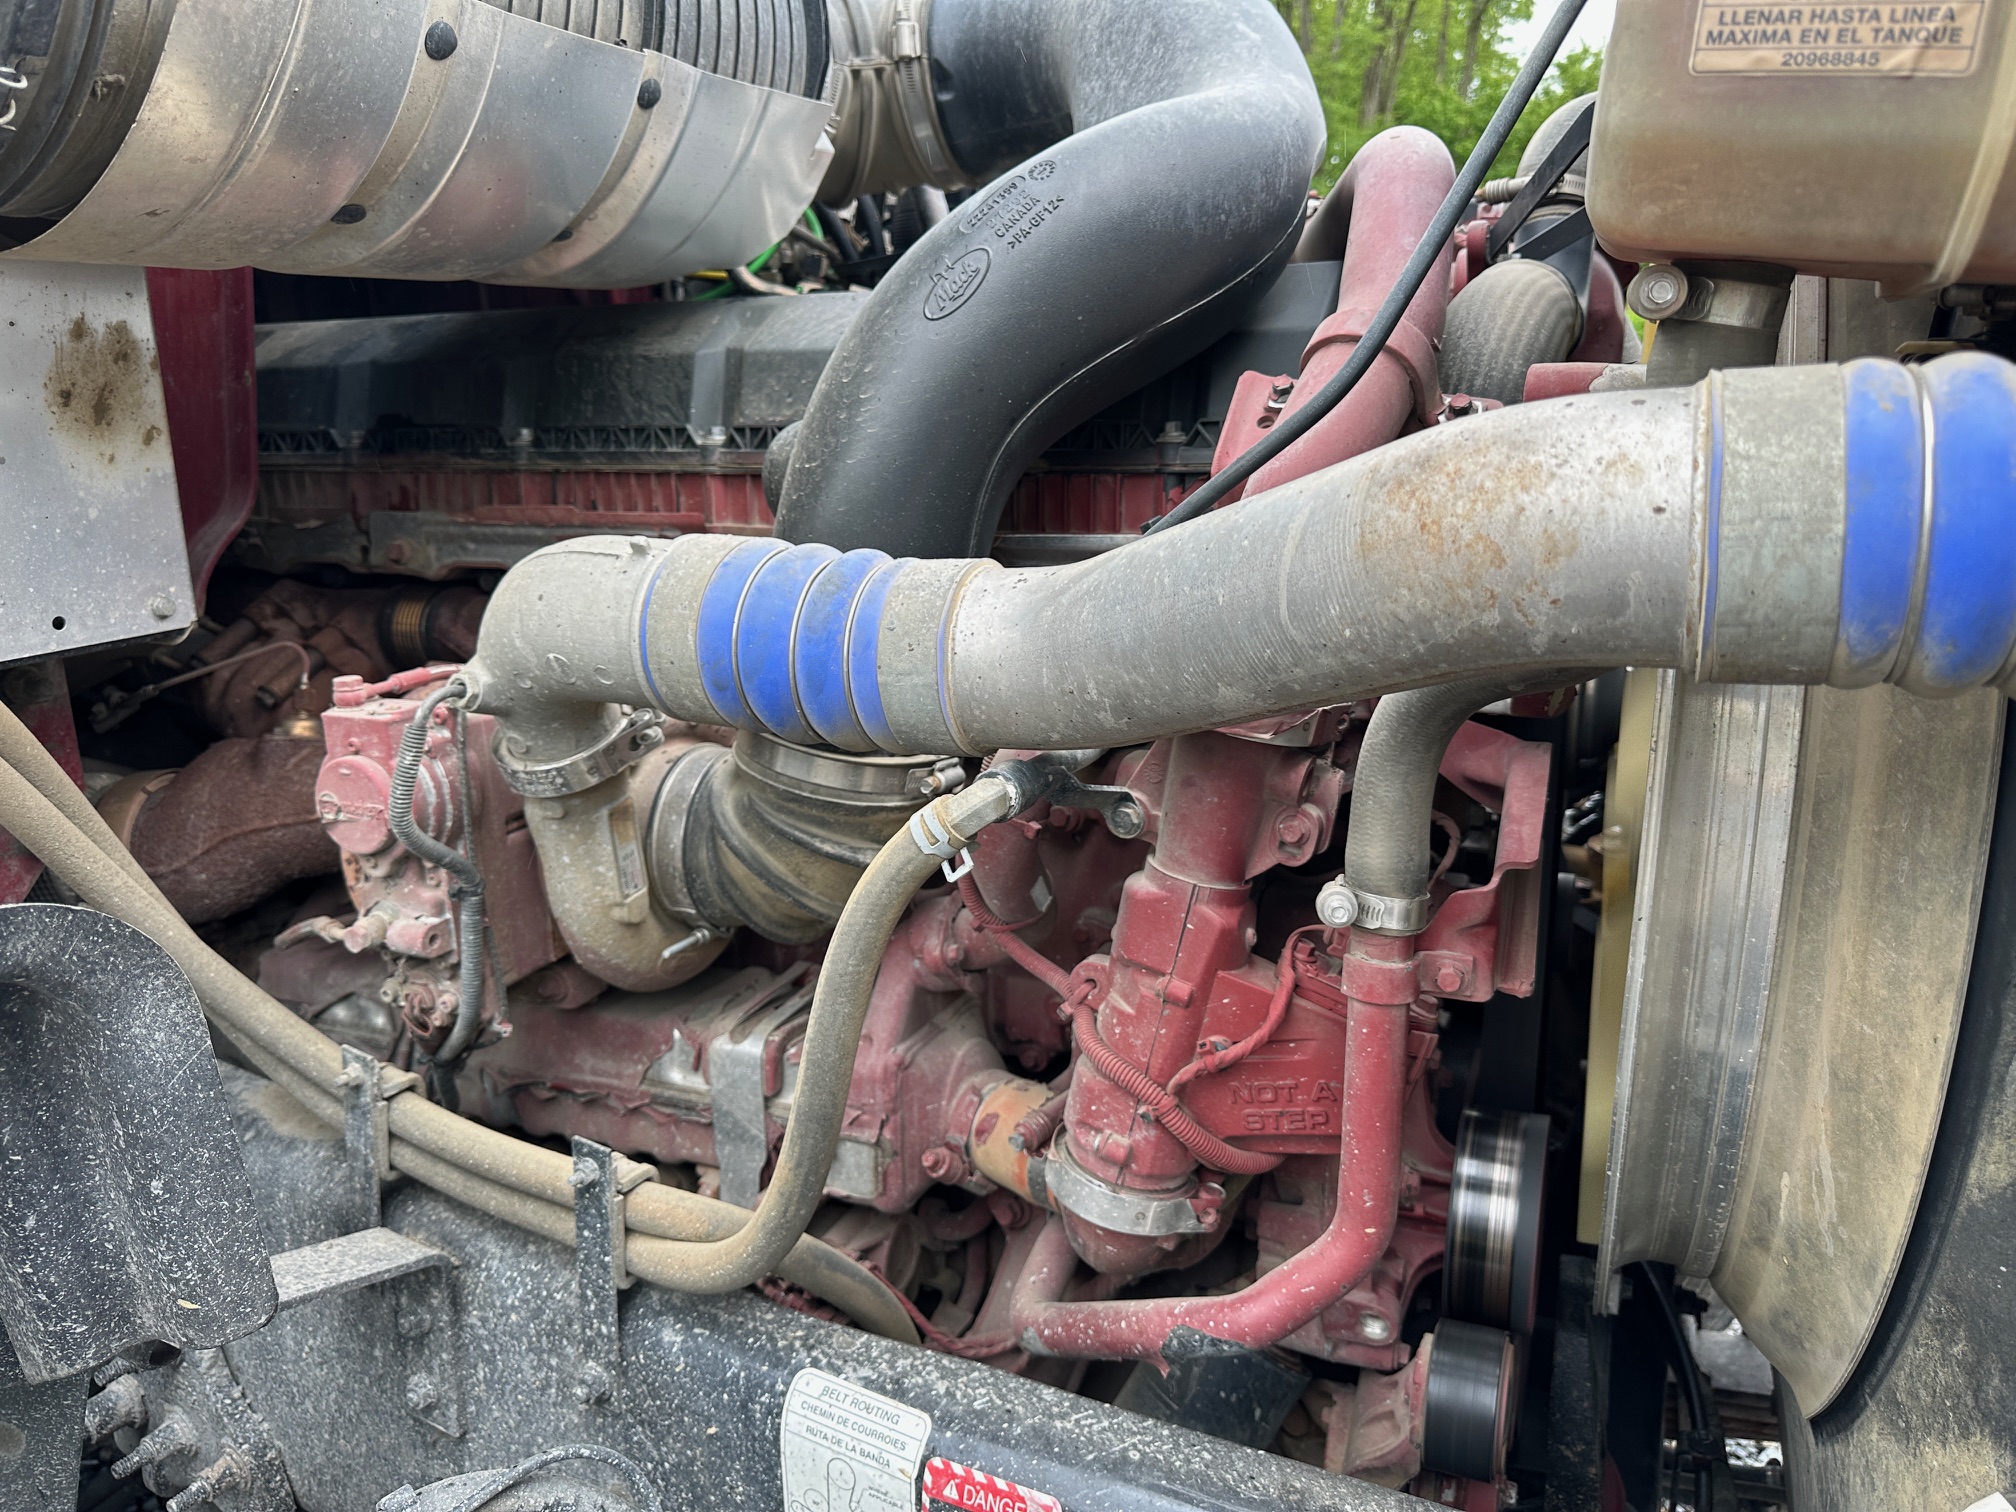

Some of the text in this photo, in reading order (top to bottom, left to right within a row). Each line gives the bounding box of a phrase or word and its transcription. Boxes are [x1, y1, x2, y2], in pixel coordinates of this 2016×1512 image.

[1717, 6, 1956, 26] LLENAR HASTA LINEA
[1705, 27, 1963, 46] MAXIMA EN EL TANQUE
[1780, 51, 1881, 67] 20968845
[994, 196, 1041, 238] CANADA
[933, 261, 981, 311] Mack
[1228, 1080, 1337, 1105] NOT A
[1242, 1107, 1328, 1131] STEP
[821, 1385, 900, 1425] BELT ROUTING
[800, 1400, 907, 1452] CHEMIN DE COURROIES
[805, 1425, 891, 1469] RUTA DE LA BANDA
[962, 1484, 1028, 1512] DANGE
